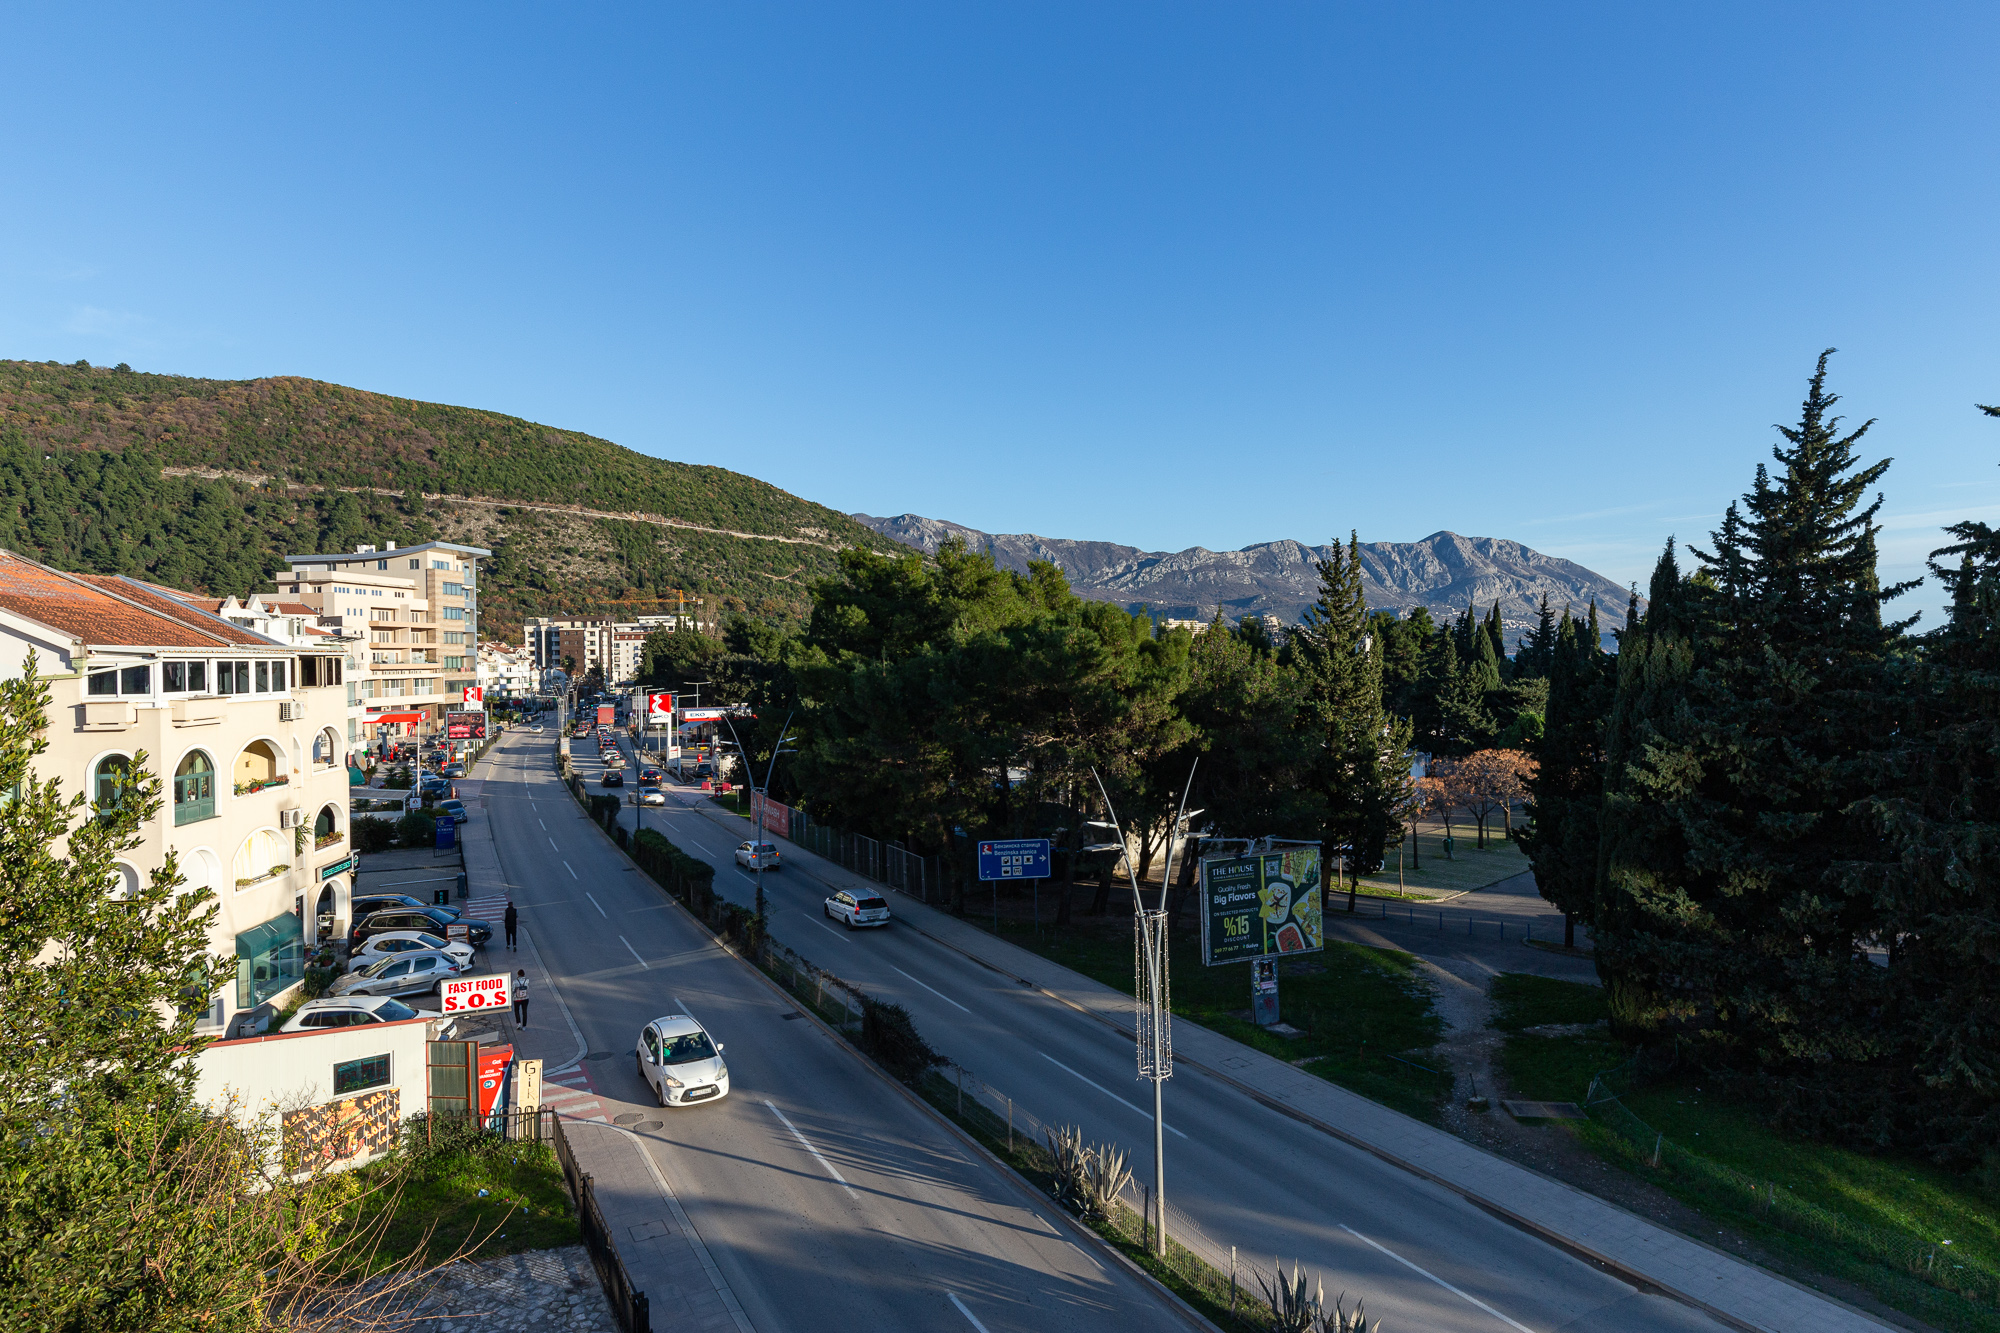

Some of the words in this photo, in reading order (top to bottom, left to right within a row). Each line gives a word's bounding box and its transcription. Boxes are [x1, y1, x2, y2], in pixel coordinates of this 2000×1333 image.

[1212, 867, 1227, 876] THE
[1228, 864, 1256, 874] HOUSE
[1236, 883, 1252, 891] Fresh
[1213, 895, 1227, 905] Big
[1228, 892, 1256, 902] Flavors
[1223, 915, 1250, 937] %15
[1223, 935, 1250, 943] DISCOUNT
[448, 981, 474, 994] FAST
[475, 978, 503, 991] FOOD
